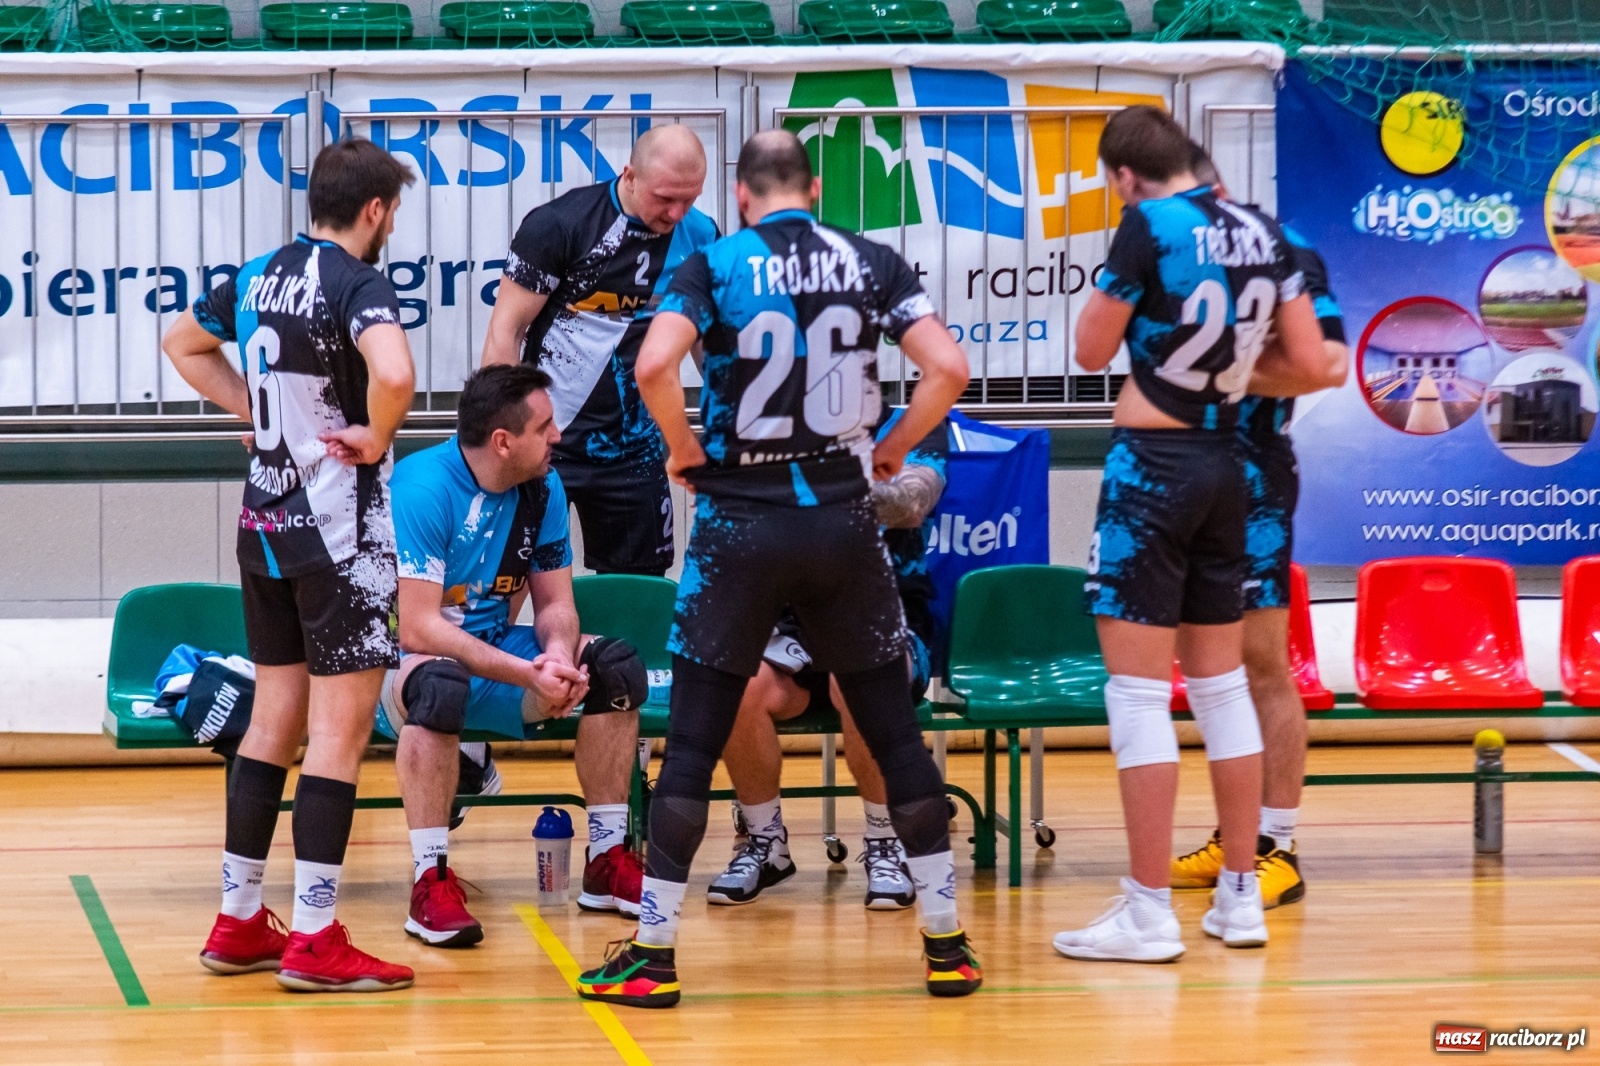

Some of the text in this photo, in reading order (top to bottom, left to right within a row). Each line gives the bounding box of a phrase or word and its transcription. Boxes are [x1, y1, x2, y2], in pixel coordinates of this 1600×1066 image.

[1503, 88, 1600, 117] Ośrod
[634, 250, 651, 286] 2
[747, 242, 866, 297] TRÓJKA
[240, 265, 318, 320] TRÓJKA
[245, 325, 283, 451] 6
[736, 304, 863, 441] 26
[1362, 484, 1600, 507] www.osir-racibor
[1362, 518, 1600, 546] www.aquapark.r
[538, 851, 547, 893] SPORTS
